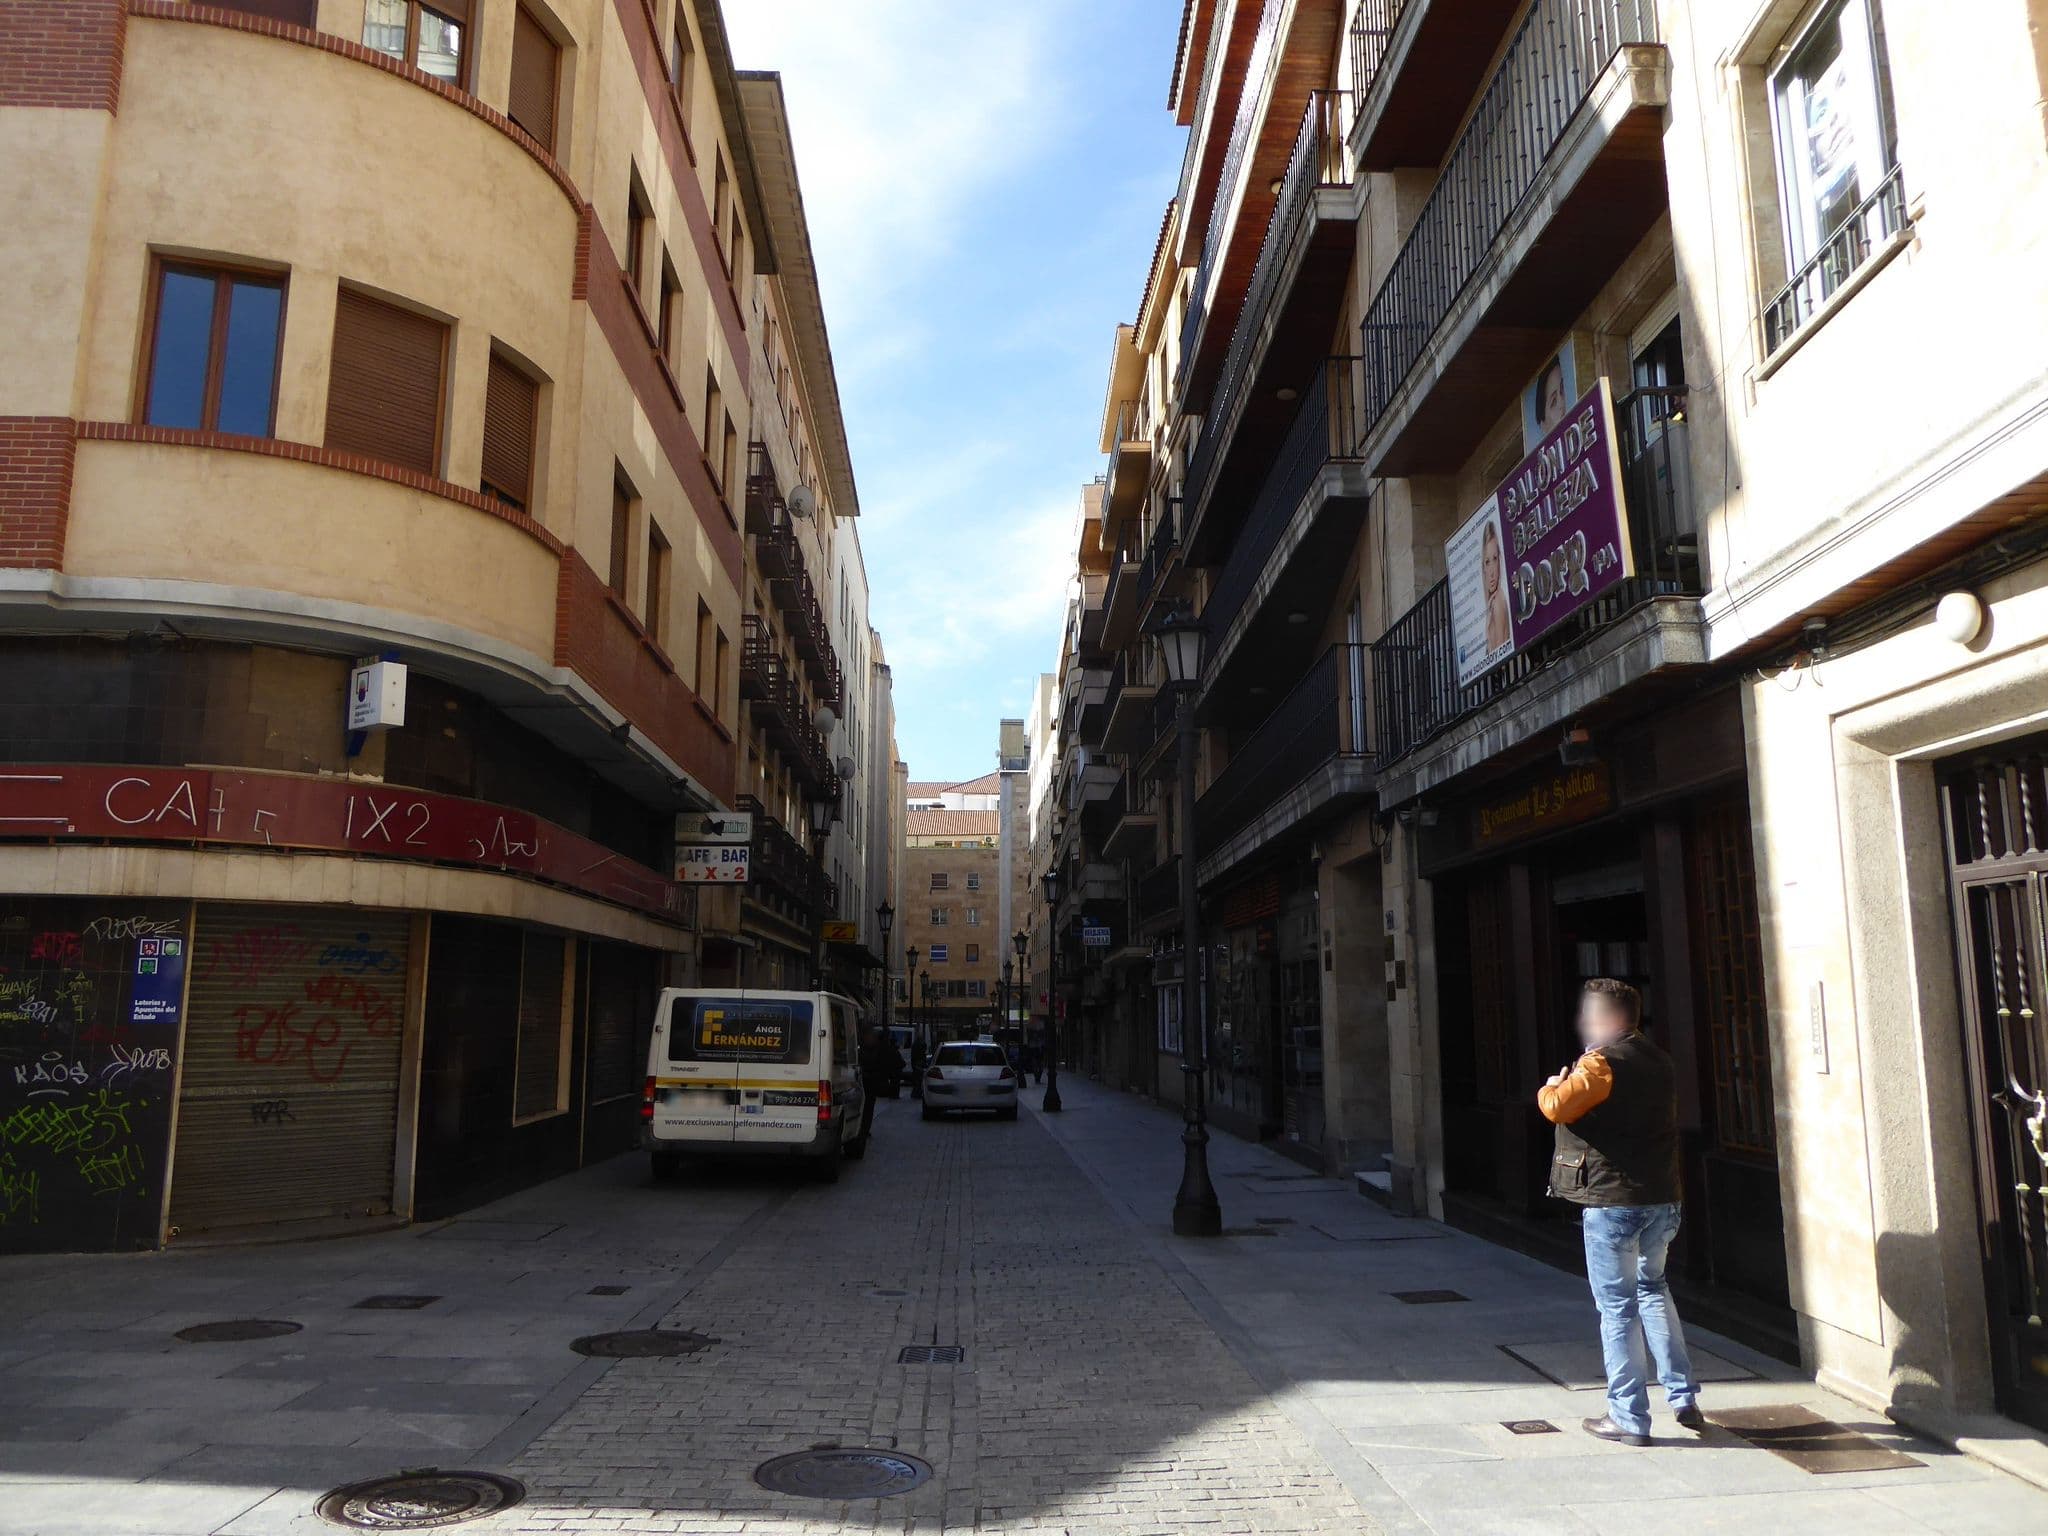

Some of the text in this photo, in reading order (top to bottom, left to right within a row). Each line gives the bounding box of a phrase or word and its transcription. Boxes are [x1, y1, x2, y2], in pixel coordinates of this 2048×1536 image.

[1505, 405, 1598, 522] SALÓN DE
[1512, 458, 1599, 559] BELLEZA
[722, 849, 748, 863] BAR
[755, 1024, 783, 1034] ÁNGEL
[664, 1118, 802, 1129] www.exclusivasangelfernandez.com
